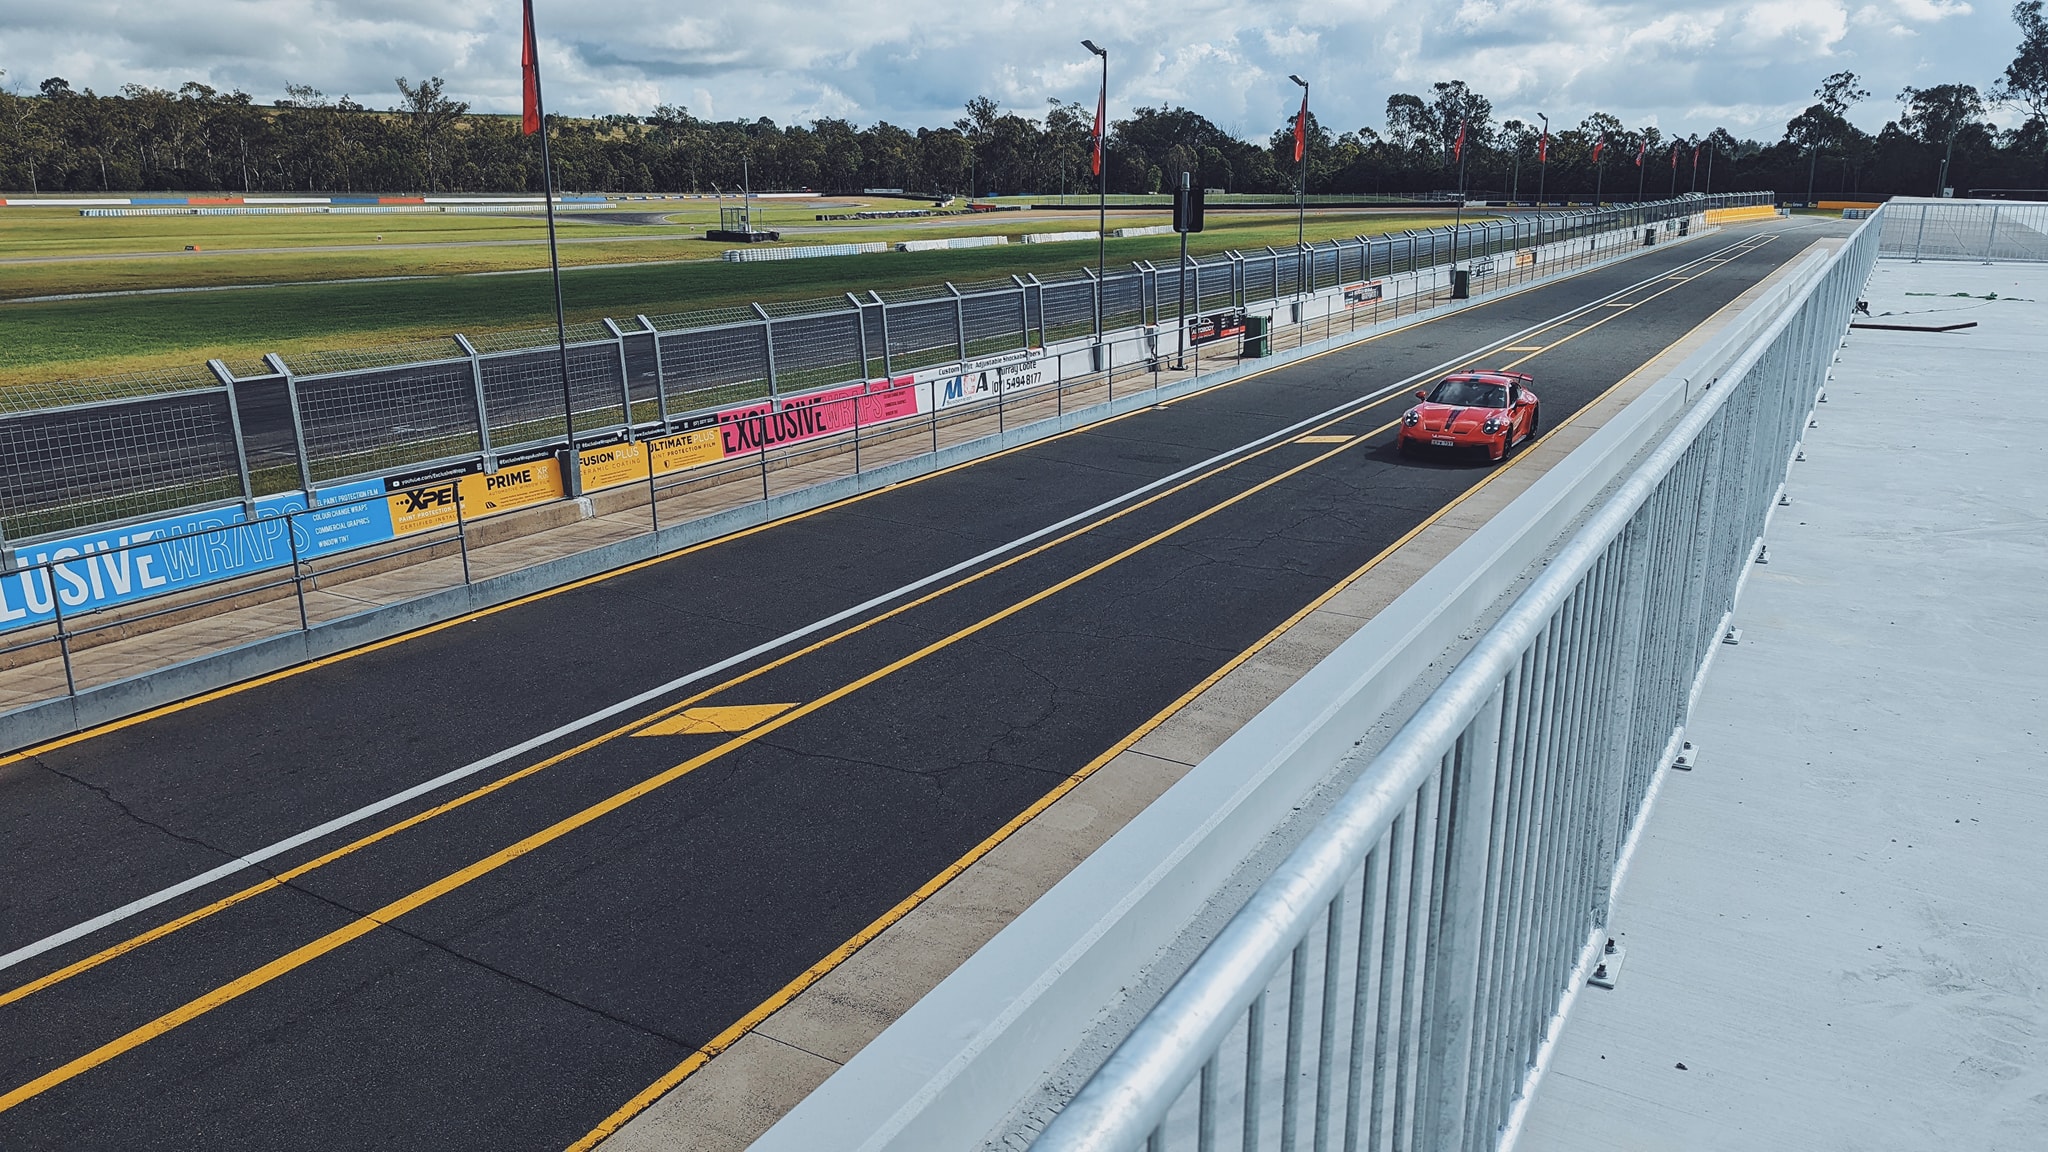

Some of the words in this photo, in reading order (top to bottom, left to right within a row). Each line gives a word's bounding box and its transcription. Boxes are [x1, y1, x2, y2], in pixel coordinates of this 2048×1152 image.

[938, 365, 960, 376] Custom
[975, 356, 1002, 368] Adjustable
[942, 371, 988, 406] MCA
[721, 397, 826, 453] EXCLUSIVE
[821, 386, 882, 429] WRAPS
[616, 446, 639, 460] PLUS
[652, 452, 665, 460] AINT
[667, 445, 702, 456] PROTECTION
[580, 464, 609, 475] ERAMIC
[612, 457, 641, 468] COATING
[486, 469, 532, 491] PRIME
[323, 496, 338, 506] PAINT
[338, 490, 367, 503] PROTECTION
[367, 488, 379, 497] FILM
[312, 511, 332, 522] COLOUR
[332, 507, 350, 517] CHANGE
[351, 504, 368, 514] WRAPS
[398, 513, 416, 523] PAINT
[417, 506, 452, 518] PROTECTION
[315, 522, 347, 535] COMMERCIAL
[347, 517, 370, 528] GRAPHICS
[400, 520, 433, 530] CERTIFIED
[155, 502, 310, 582] WRAPS
[318, 538, 339, 548] WINDOW
[340, 535, 350, 544] TINT
